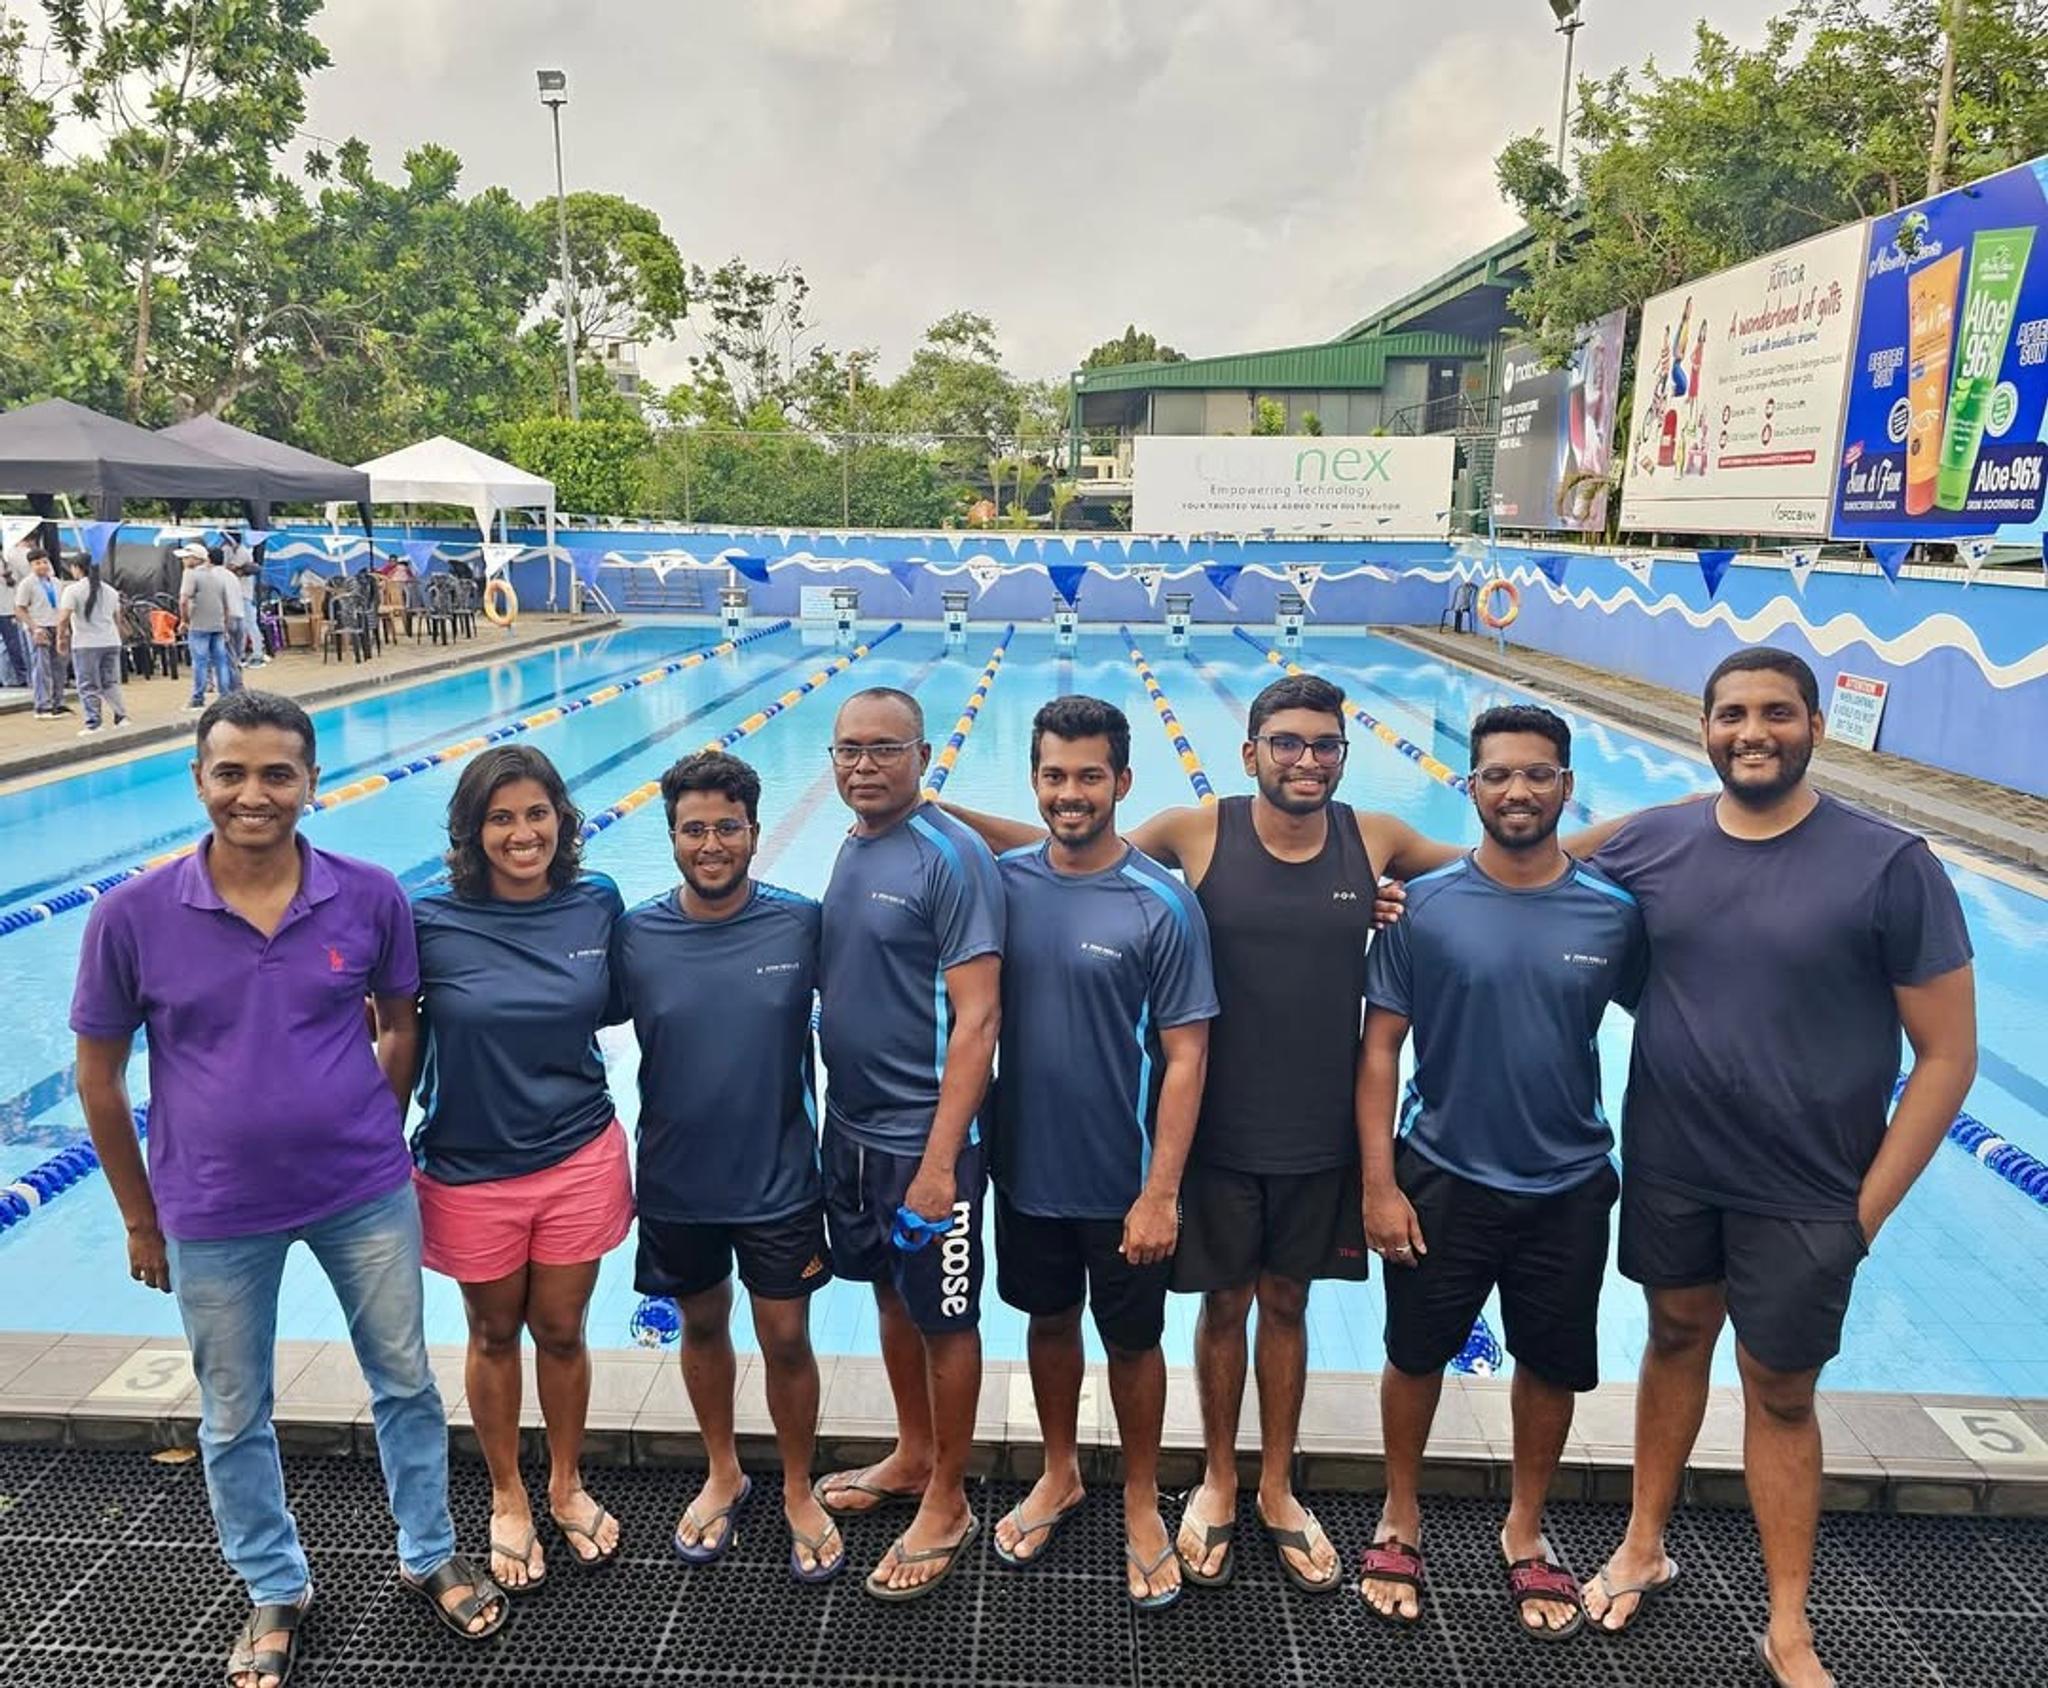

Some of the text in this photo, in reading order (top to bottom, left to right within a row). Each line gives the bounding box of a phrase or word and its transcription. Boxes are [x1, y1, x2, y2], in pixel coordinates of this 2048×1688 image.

[1728, 280, 1842, 342] A wonderland of gifts
[1964, 290, 2009, 334] Aloe
[1962, 333, 2001, 379] 96%
[2020, 341, 2048, 366] SUN
[1210, 484, 1372, 498] Empowering Technology
[1975, 455, 2043, 492] Aloe 96%
[1182, 502, 1205, 510] YOUR
[1208, 502, 1247, 510] TRUSTED
[1281, 502, 1311, 510] ADDED
[1314, 502, 1338, 510] TECH
[1340, 502, 1399, 510] DISTRIBUTOR
[2020, 499, 2035, 509] GEL
[941, 1201, 981, 1317] moose
[126, 1356, 186, 1391] 3
[1960, 1415, 2026, 1454] 5
